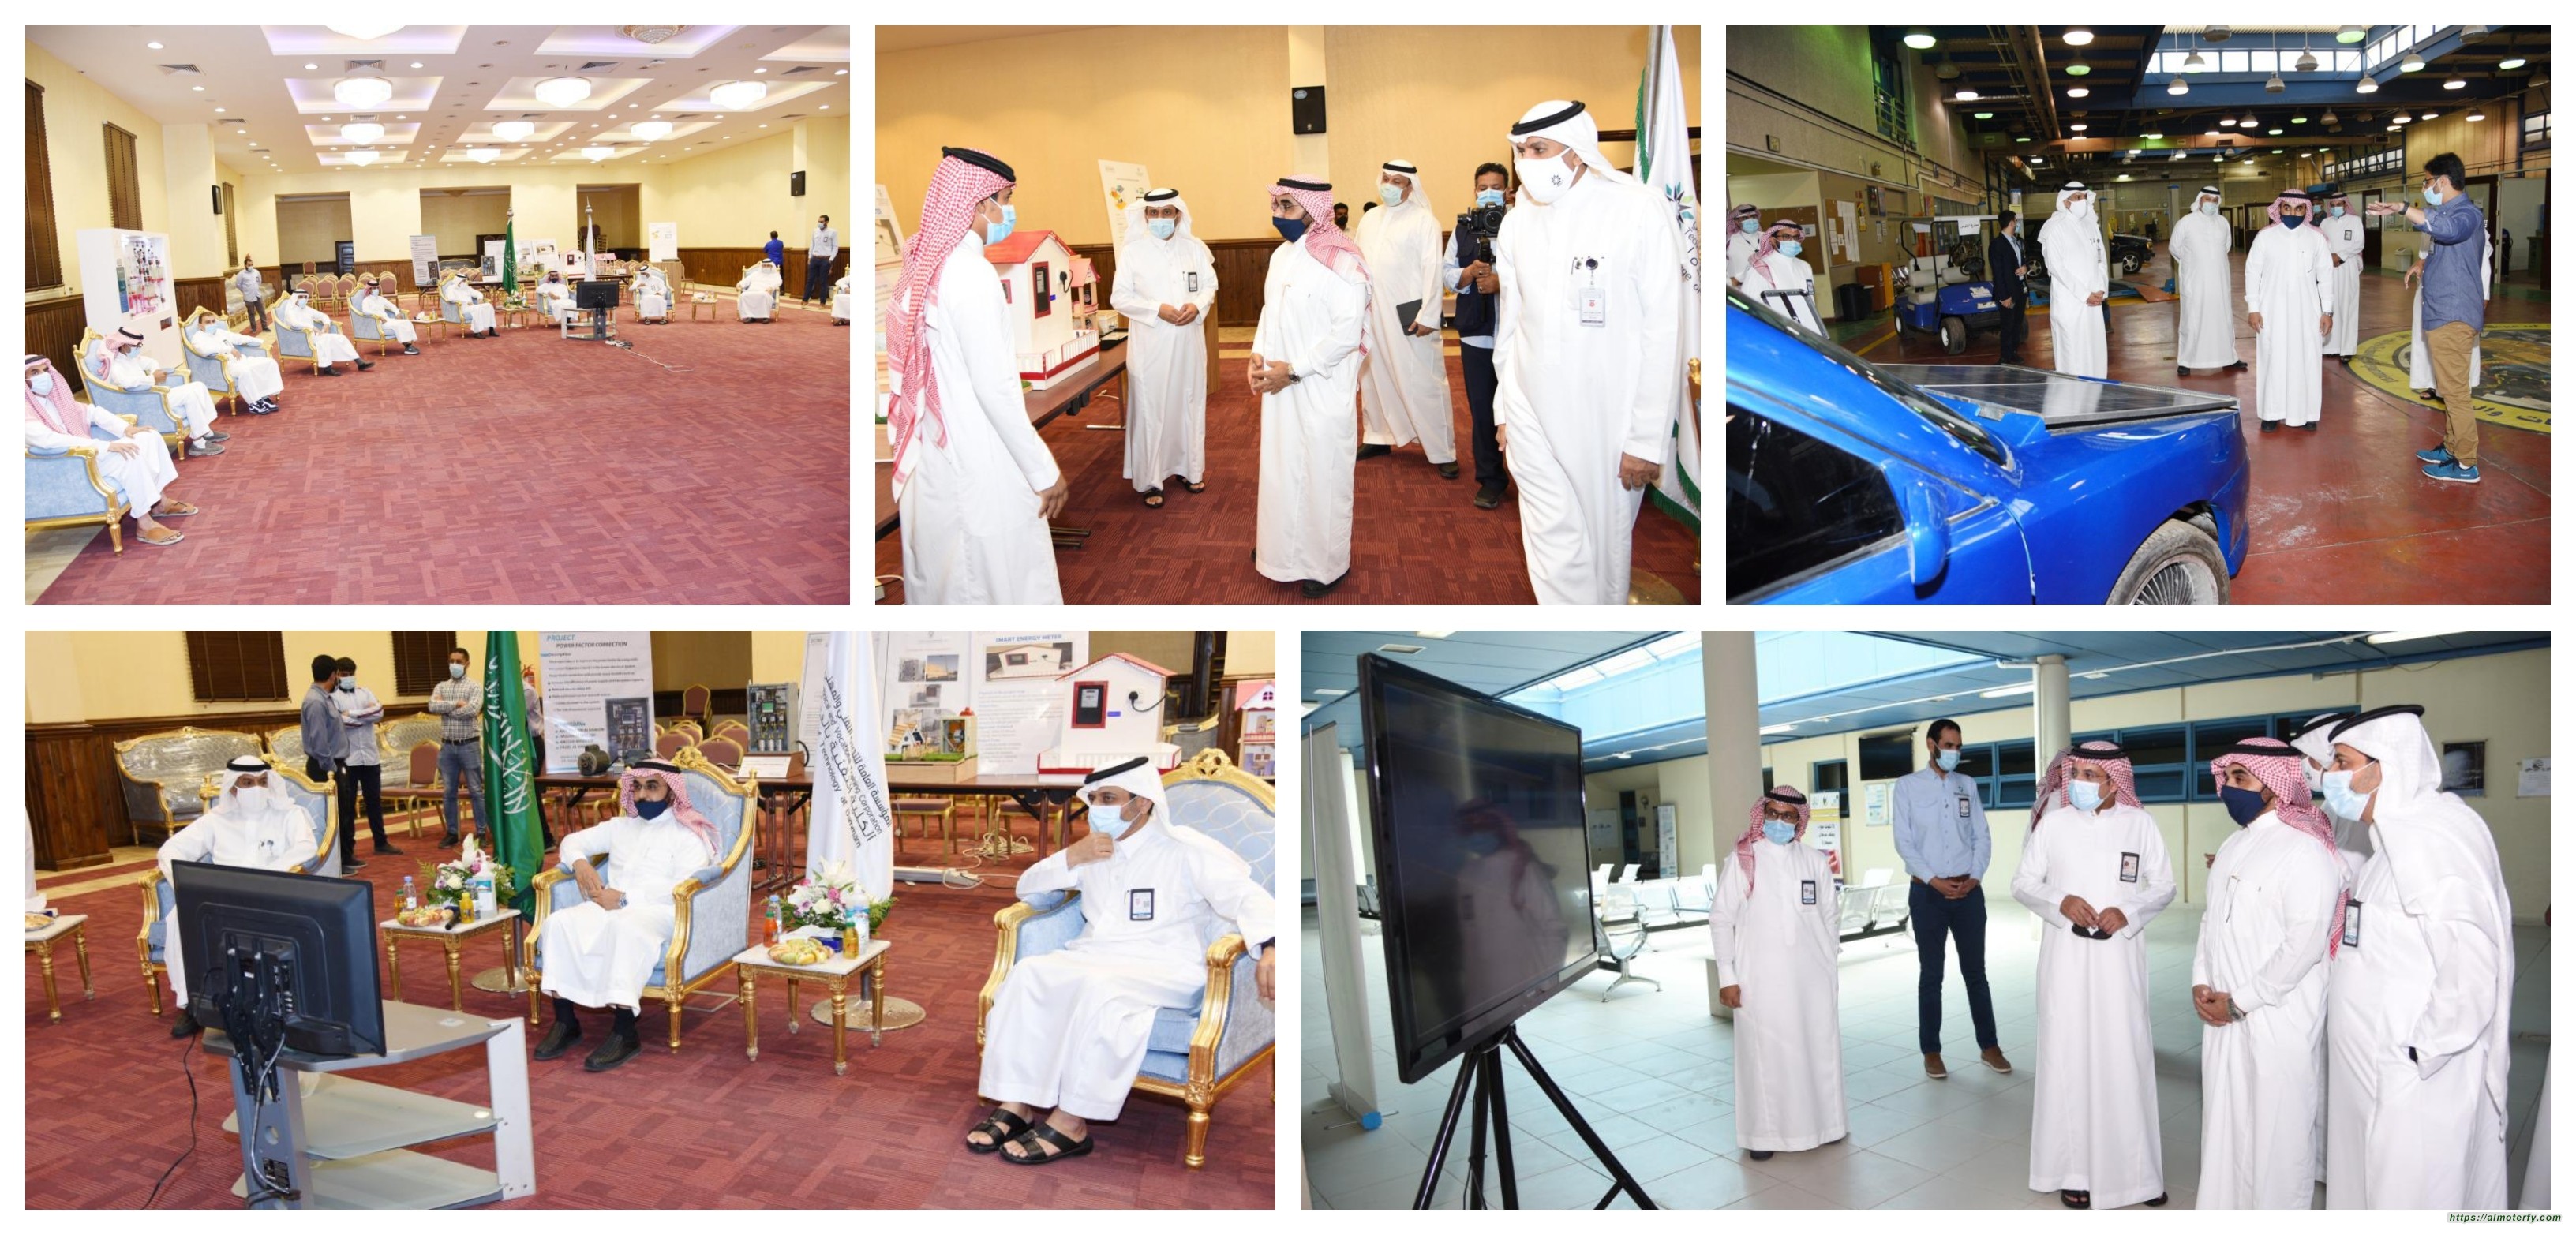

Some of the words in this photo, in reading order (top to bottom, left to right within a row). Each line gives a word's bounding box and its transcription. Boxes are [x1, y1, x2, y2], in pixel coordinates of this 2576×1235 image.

[819, 741, 842, 792] Technology
[841, 795, 848, 806] at
[859, 794, 882, 834] Corporation
